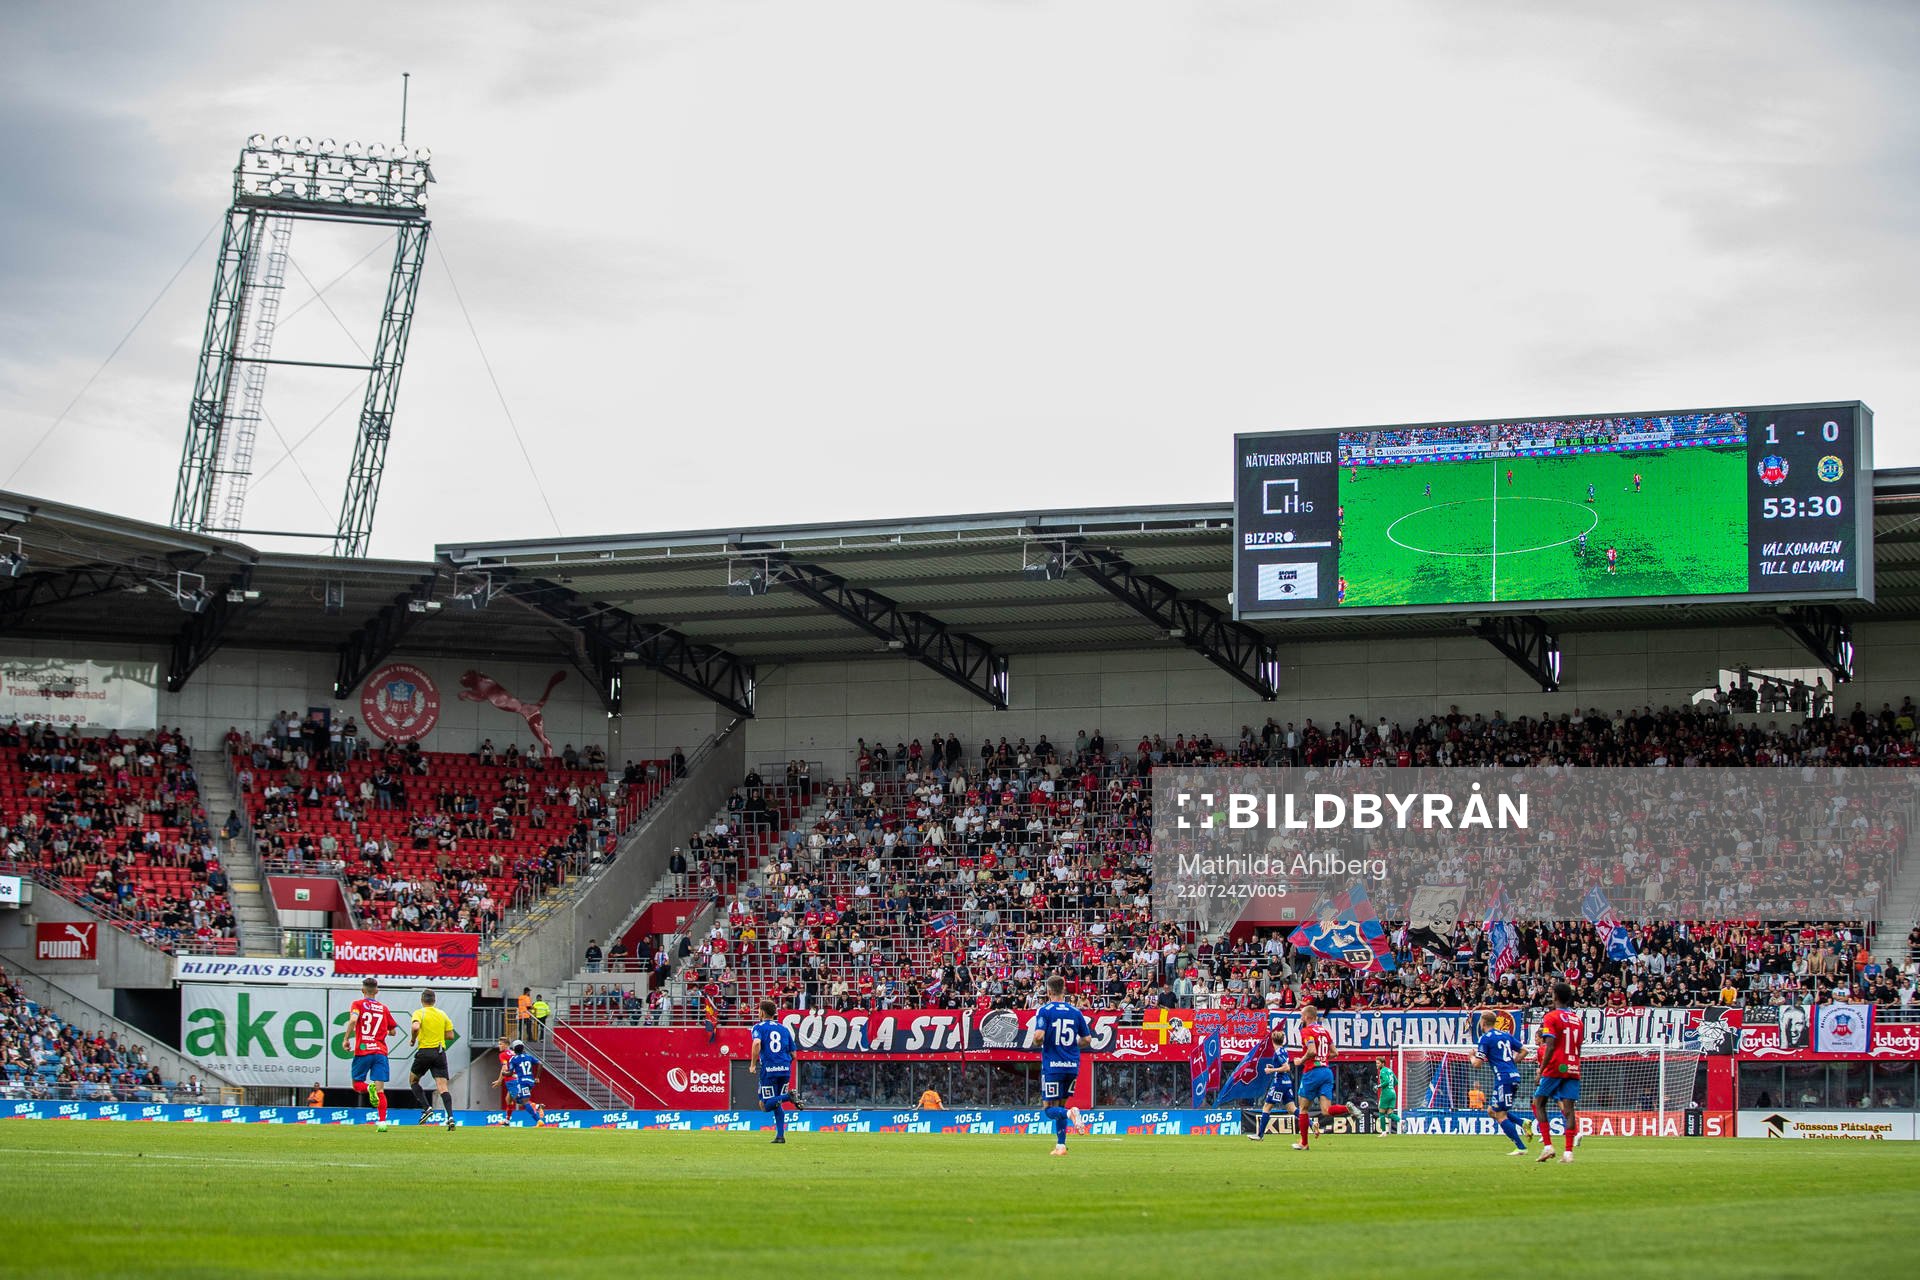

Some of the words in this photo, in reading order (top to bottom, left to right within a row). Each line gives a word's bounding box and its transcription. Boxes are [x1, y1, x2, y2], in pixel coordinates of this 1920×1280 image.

[1765, 423, 1779, 444] 1
[1822, 421, 1839, 442] 0
[1245, 451, 1332, 468] NÄTVERKSPARTNER
[1763, 495, 1842, 519] 53:30
[1760, 560, 1788, 575] TILL
[1792, 559, 1845, 575] OLYMPIA
[6, 670, 89, 687] Helsingborgs
[7, 686, 107, 701] Takentreprenad
[39, 940, 82, 959] PUMA
[335, 941, 438, 963] HÖGERSVÄNGEN
[181, 961, 275, 977] KLIPPANS
[278, 965, 326, 978] BUSS
[1606, 1006, 1644, 1016] ACAB
[361, 1011, 384, 1036] 37
[1051, 1018, 1075, 1047] 15
[769, 1030, 782, 1053] 8
[1317, 1035, 1329, 1057] 16
[207, 1063, 232, 1071] PART
[235, 1064, 249, 1072] OF
[252, 1064, 284, 1073] ELEDA
[287, 1065, 321, 1073] GROUP
[519, 1060, 532, 1076] 12
[690, 1069, 726, 1084] beat
[689, 1084, 725, 1093] diabetes
[544, 1111, 570, 1123] 105.5
[602, 1112, 628, 1123] 105.5
[655, 1112, 681, 1124] 105.5
[712, 1112, 739, 1124] 105.5
[832, 1112, 859, 1124] 105.5
[892, 1112, 919, 1124] 105.5
[954, 1112, 982, 1124] 105.5
[1012, 1112, 1041, 1124] 105.5
[1140, 1112, 1169, 1124] 105.5
[1204, 1112, 1233, 1124] 105.5
[1792, 1122, 1838, 1131] Jönssons
[1840, 1122, 1893, 1133] Plåtslageri
